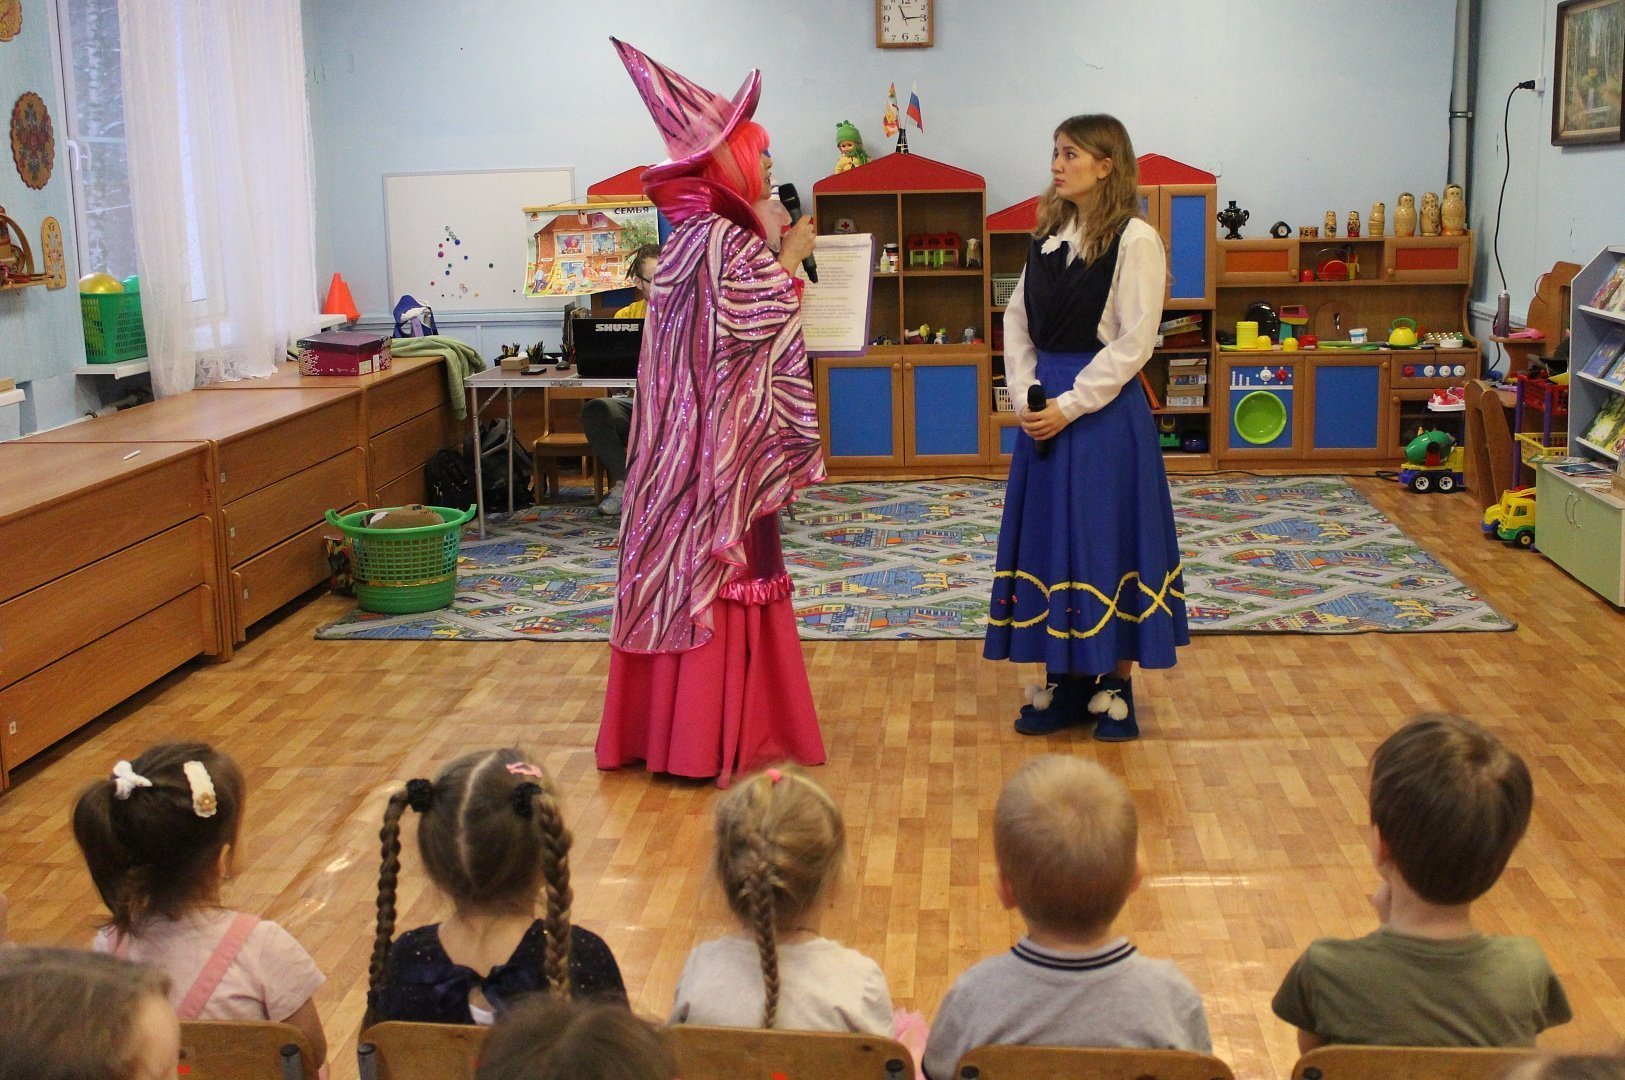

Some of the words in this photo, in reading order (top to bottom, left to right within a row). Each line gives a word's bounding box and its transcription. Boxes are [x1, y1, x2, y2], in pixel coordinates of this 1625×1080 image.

[883, 15, 890, 23] 9
[920, 14, 927, 22] 3
[902, 33, 909, 41] 6
[614, 206, 649, 214] СЕМЬЯ
[595, 323, 639, 332] SHURE
